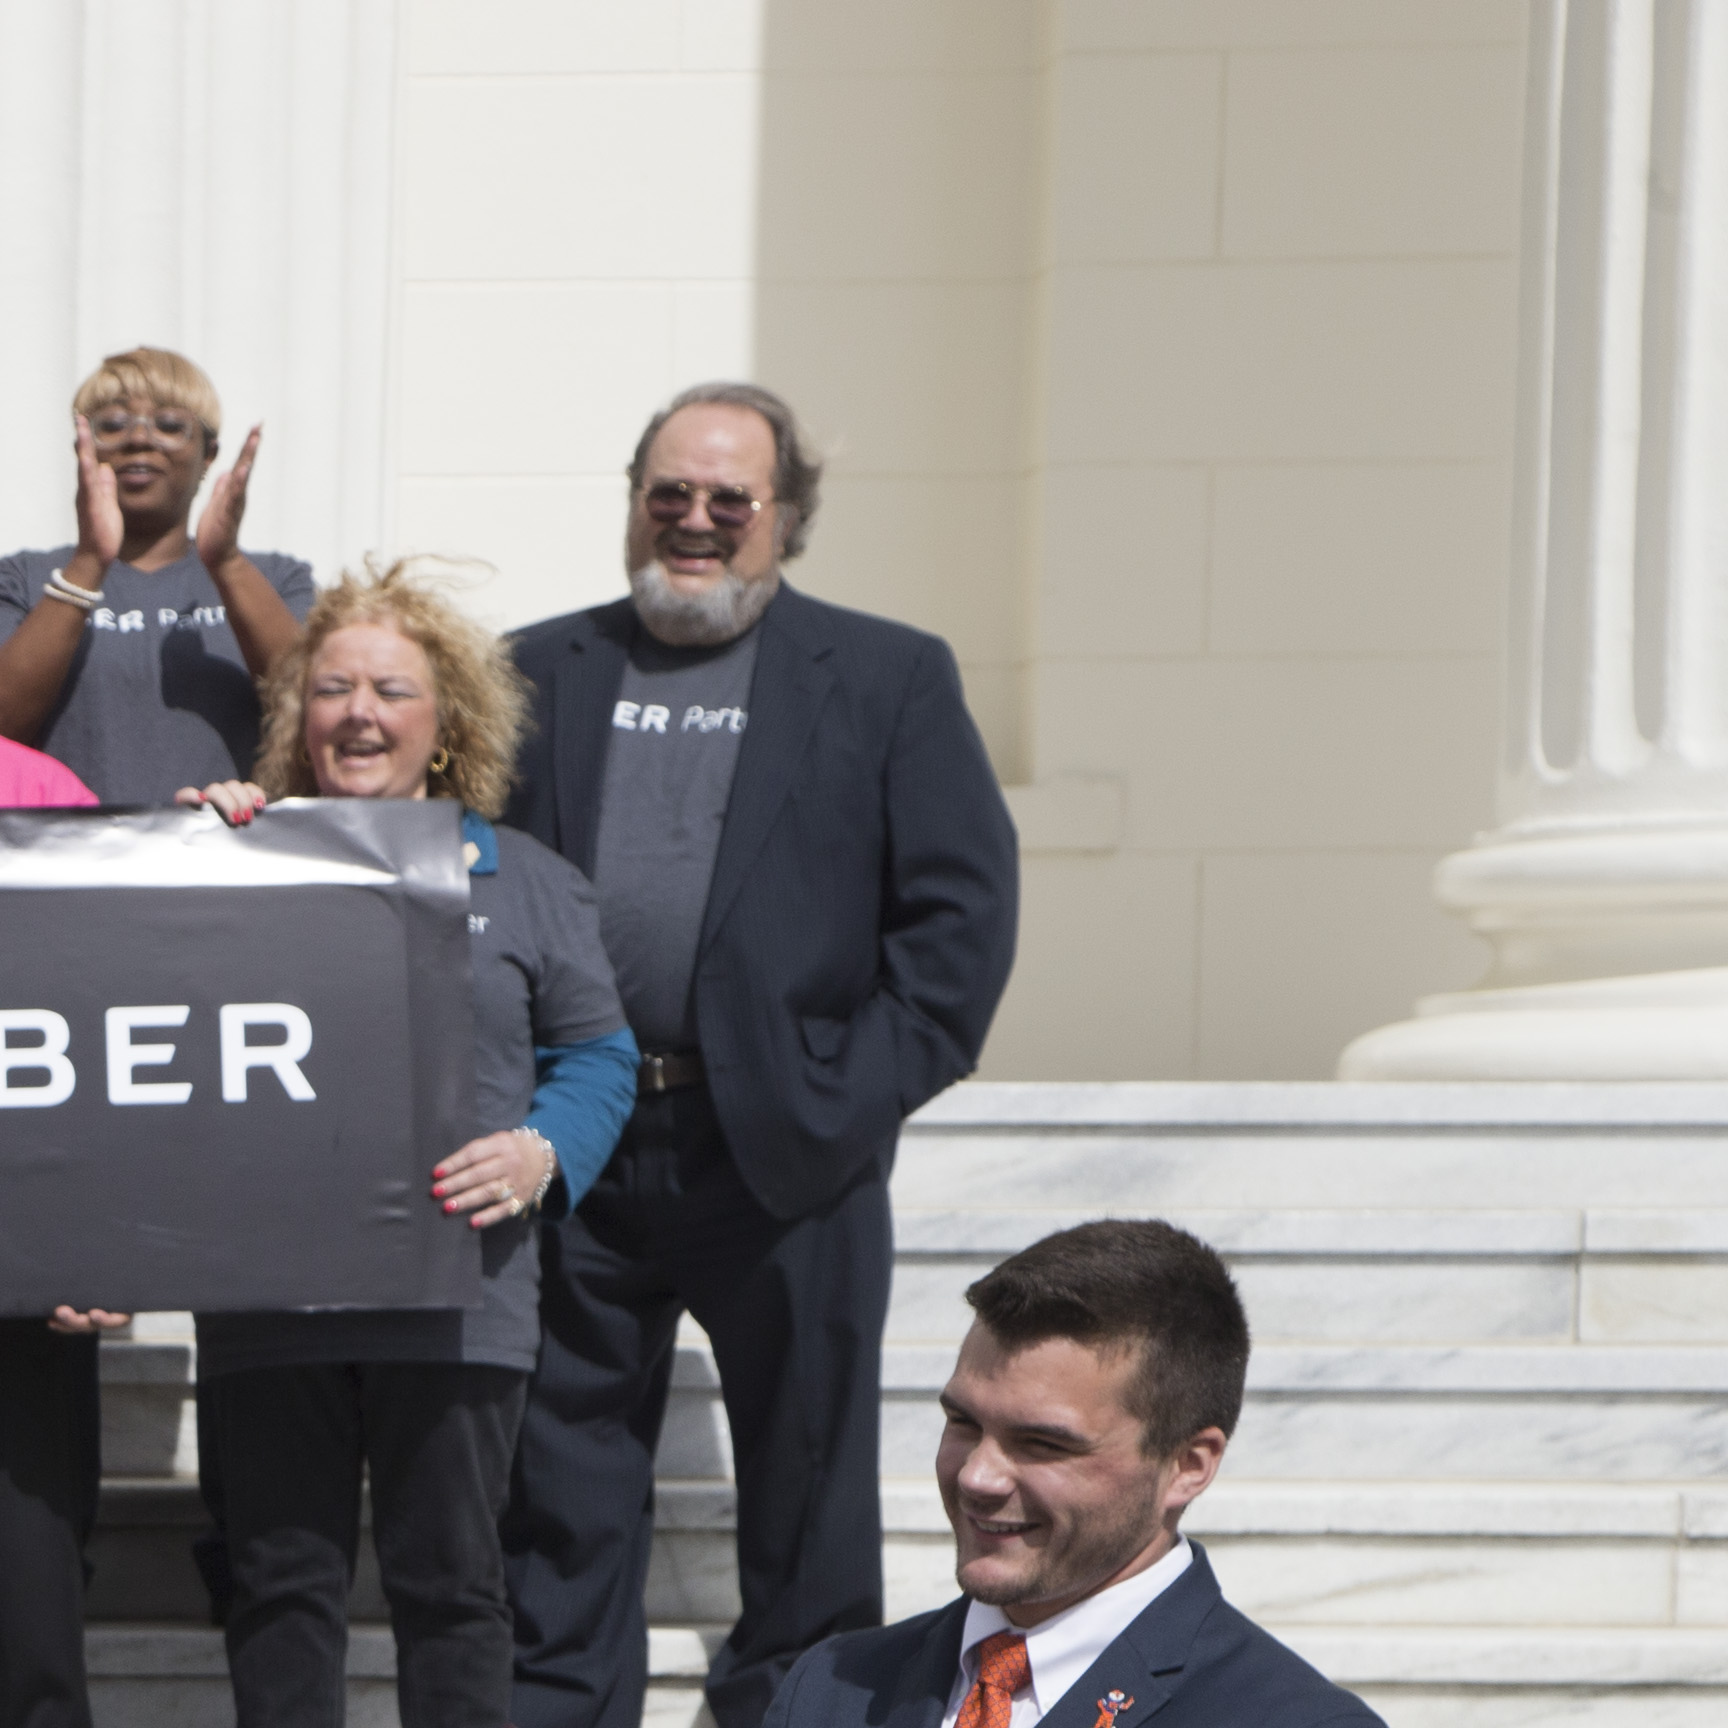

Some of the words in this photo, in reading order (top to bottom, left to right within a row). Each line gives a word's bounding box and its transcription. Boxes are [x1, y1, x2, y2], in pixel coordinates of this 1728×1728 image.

[93, 607, 145, 634] ER
[612, 700, 671, 734] ER
[680, 705, 748, 734] Part
